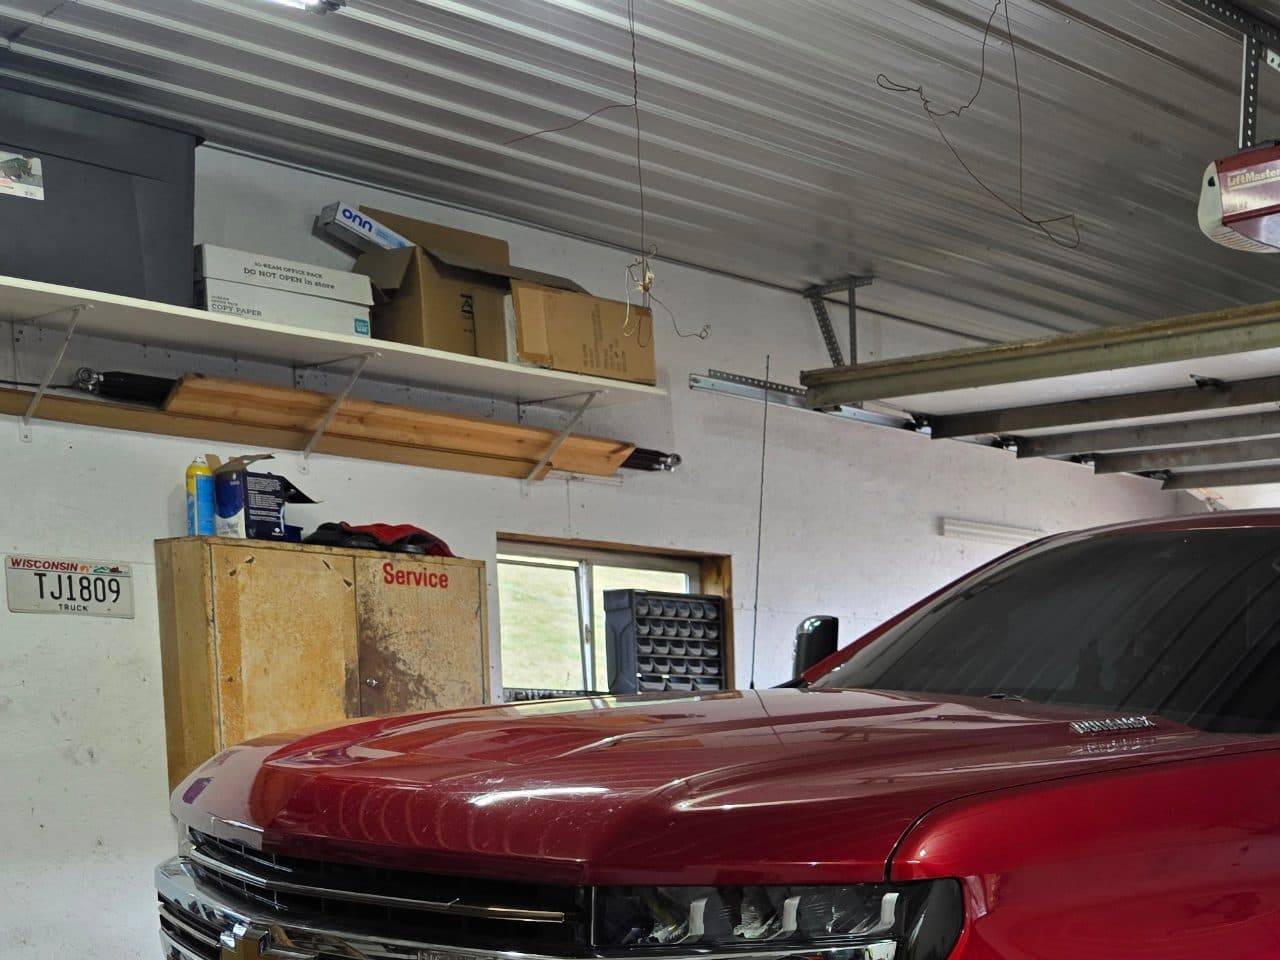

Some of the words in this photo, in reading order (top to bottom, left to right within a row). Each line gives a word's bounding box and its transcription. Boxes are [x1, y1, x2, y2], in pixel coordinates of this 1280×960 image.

[1227, 168, 1280, 188] LiftMaster
[342, 208, 373, 233] onn
[243, 267, 257, 277] DO
[258, 269, 277, 280] NOT
[279, 273, 302, 284] OPEN
[304, 276, 313, 286] in
[315, 280, 336, 290] store
[211, 303, 234, 313] COPY
[235, 307, 263, 317] PAPER
[11, 558, 78, 572] WISCONSIN
[382, 562, 449, 589] Service
[34, 572, 121, 603] TJ1809
[58, 603, 88, 612] TRUCK
